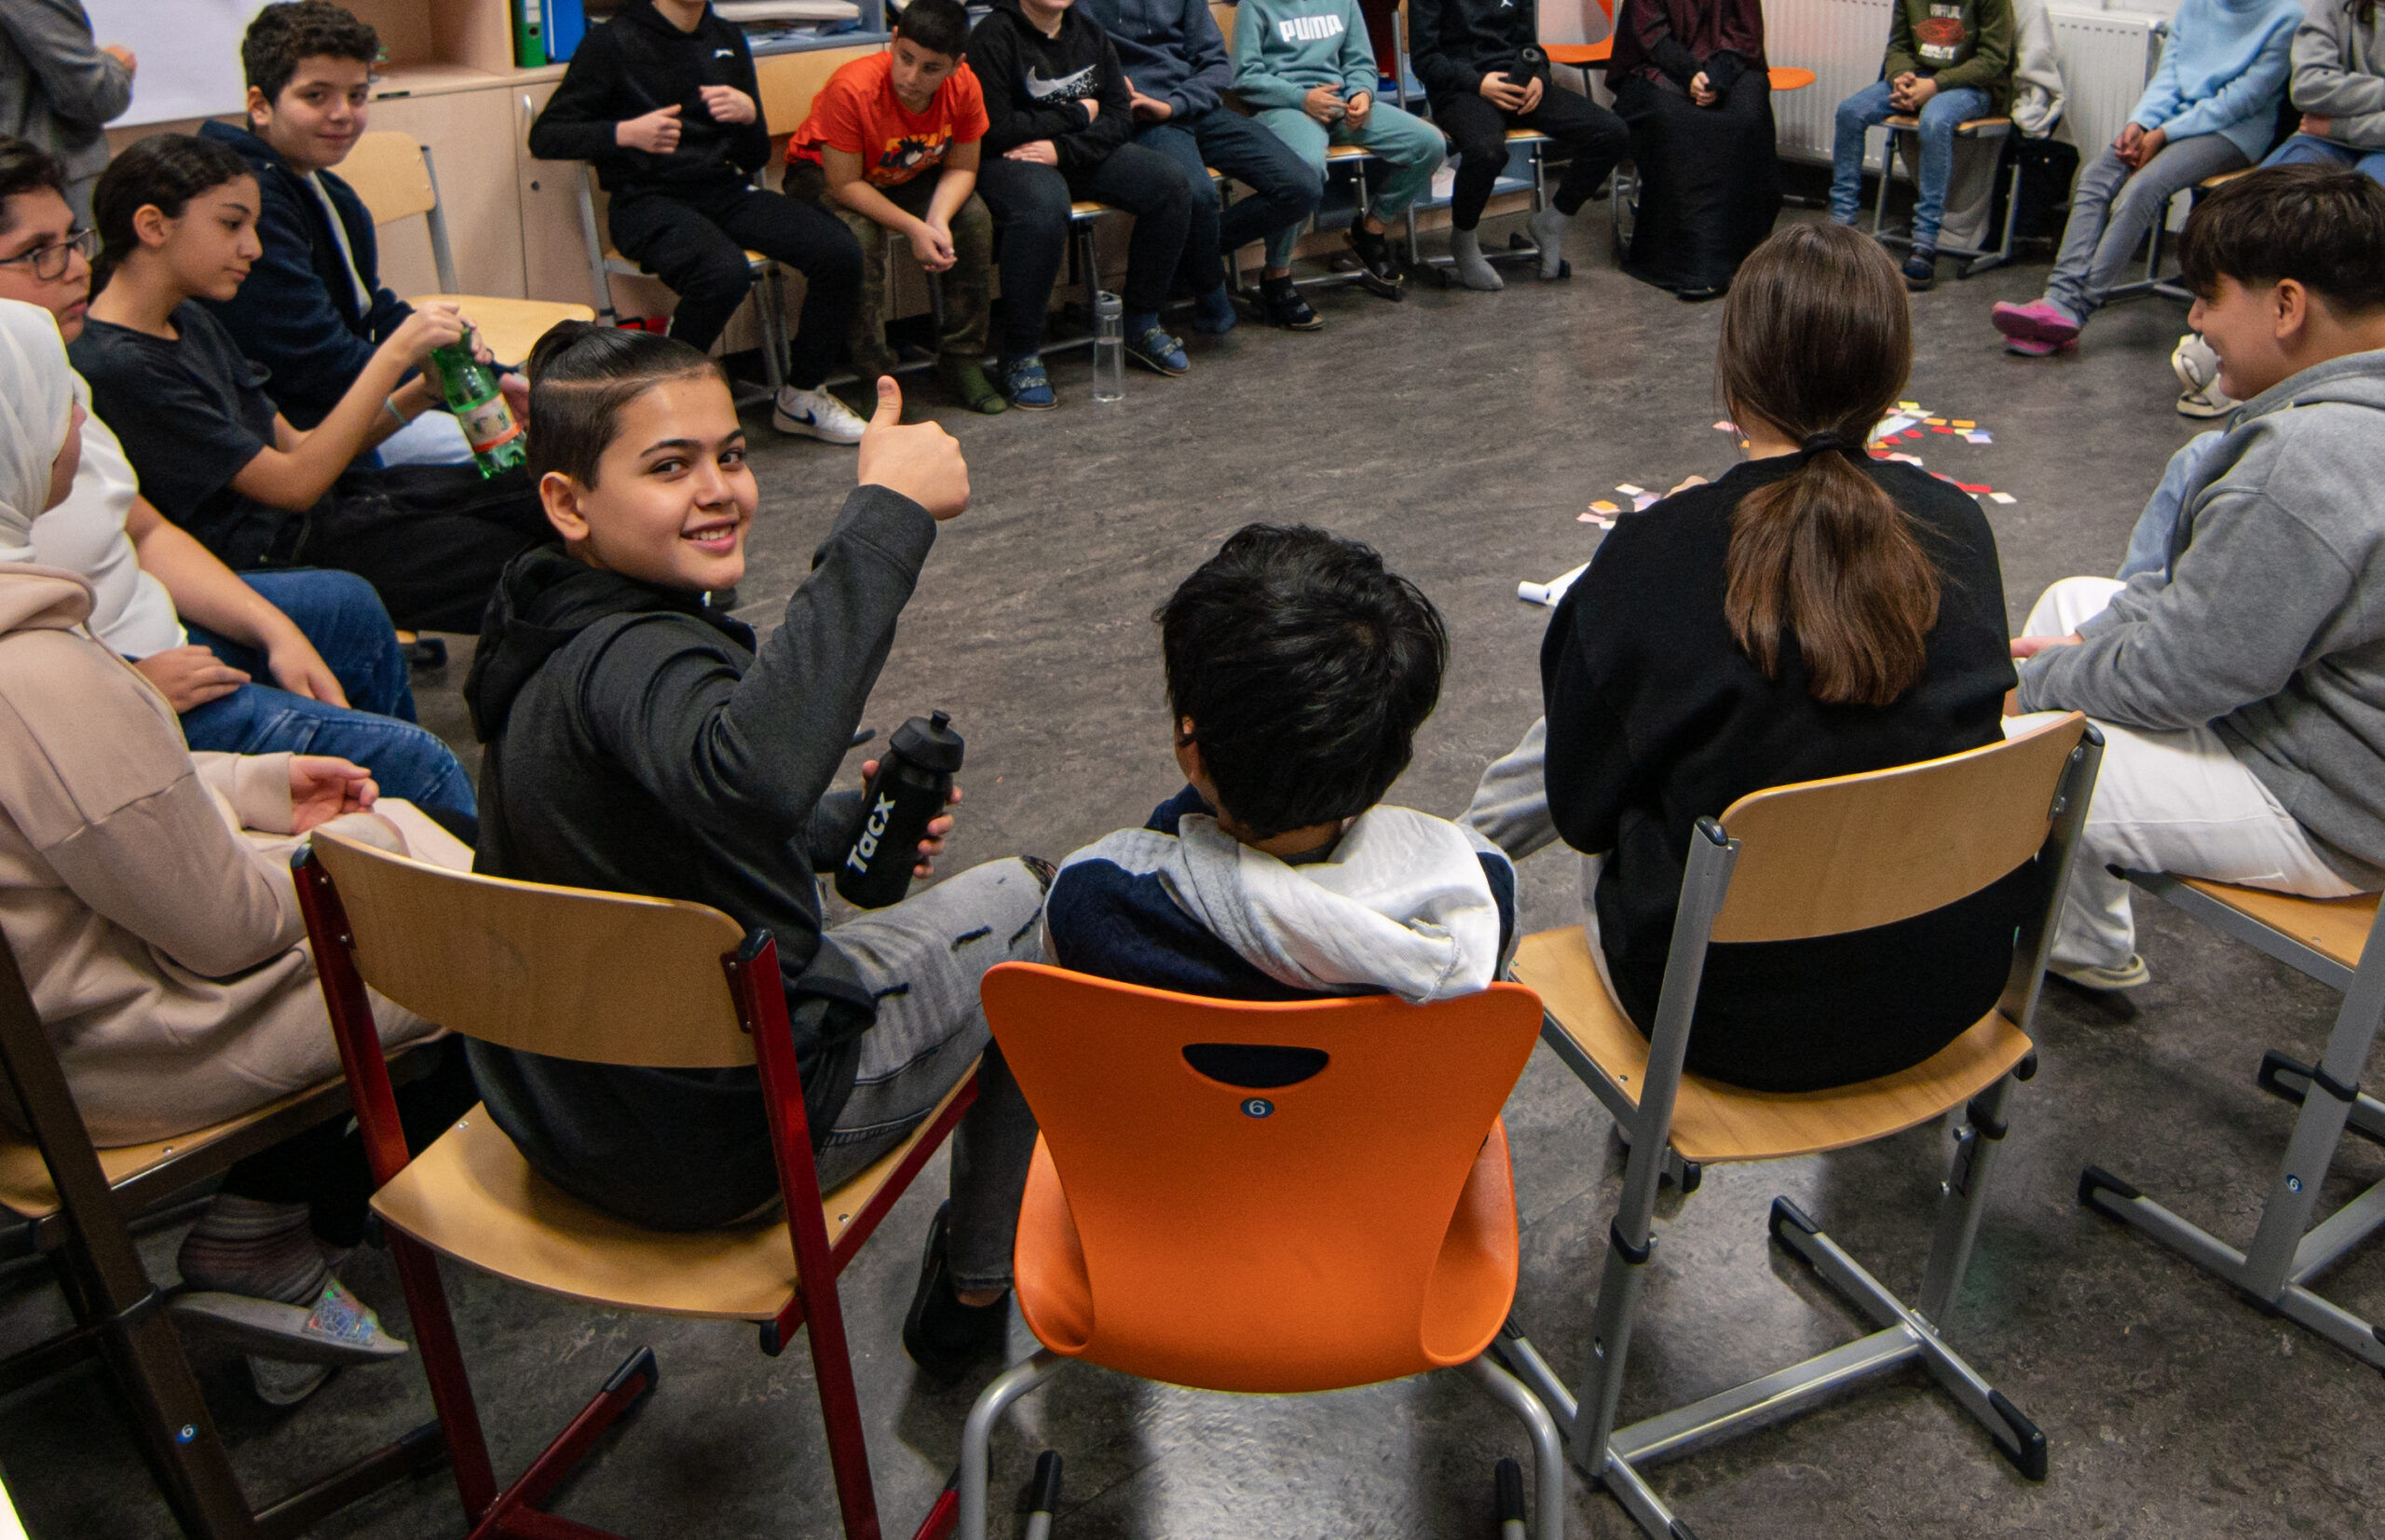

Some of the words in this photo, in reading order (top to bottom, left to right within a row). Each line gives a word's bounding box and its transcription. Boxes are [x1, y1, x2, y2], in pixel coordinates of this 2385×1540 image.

[1279, 14, 1343, 42] PUMA
[847, 791, 895, 873] Tacx
[1248, 1100, 1266, 1115] 6
[2289, 1178, 2299, 1191] 6
[182, 1424, 194, 1438] 6
